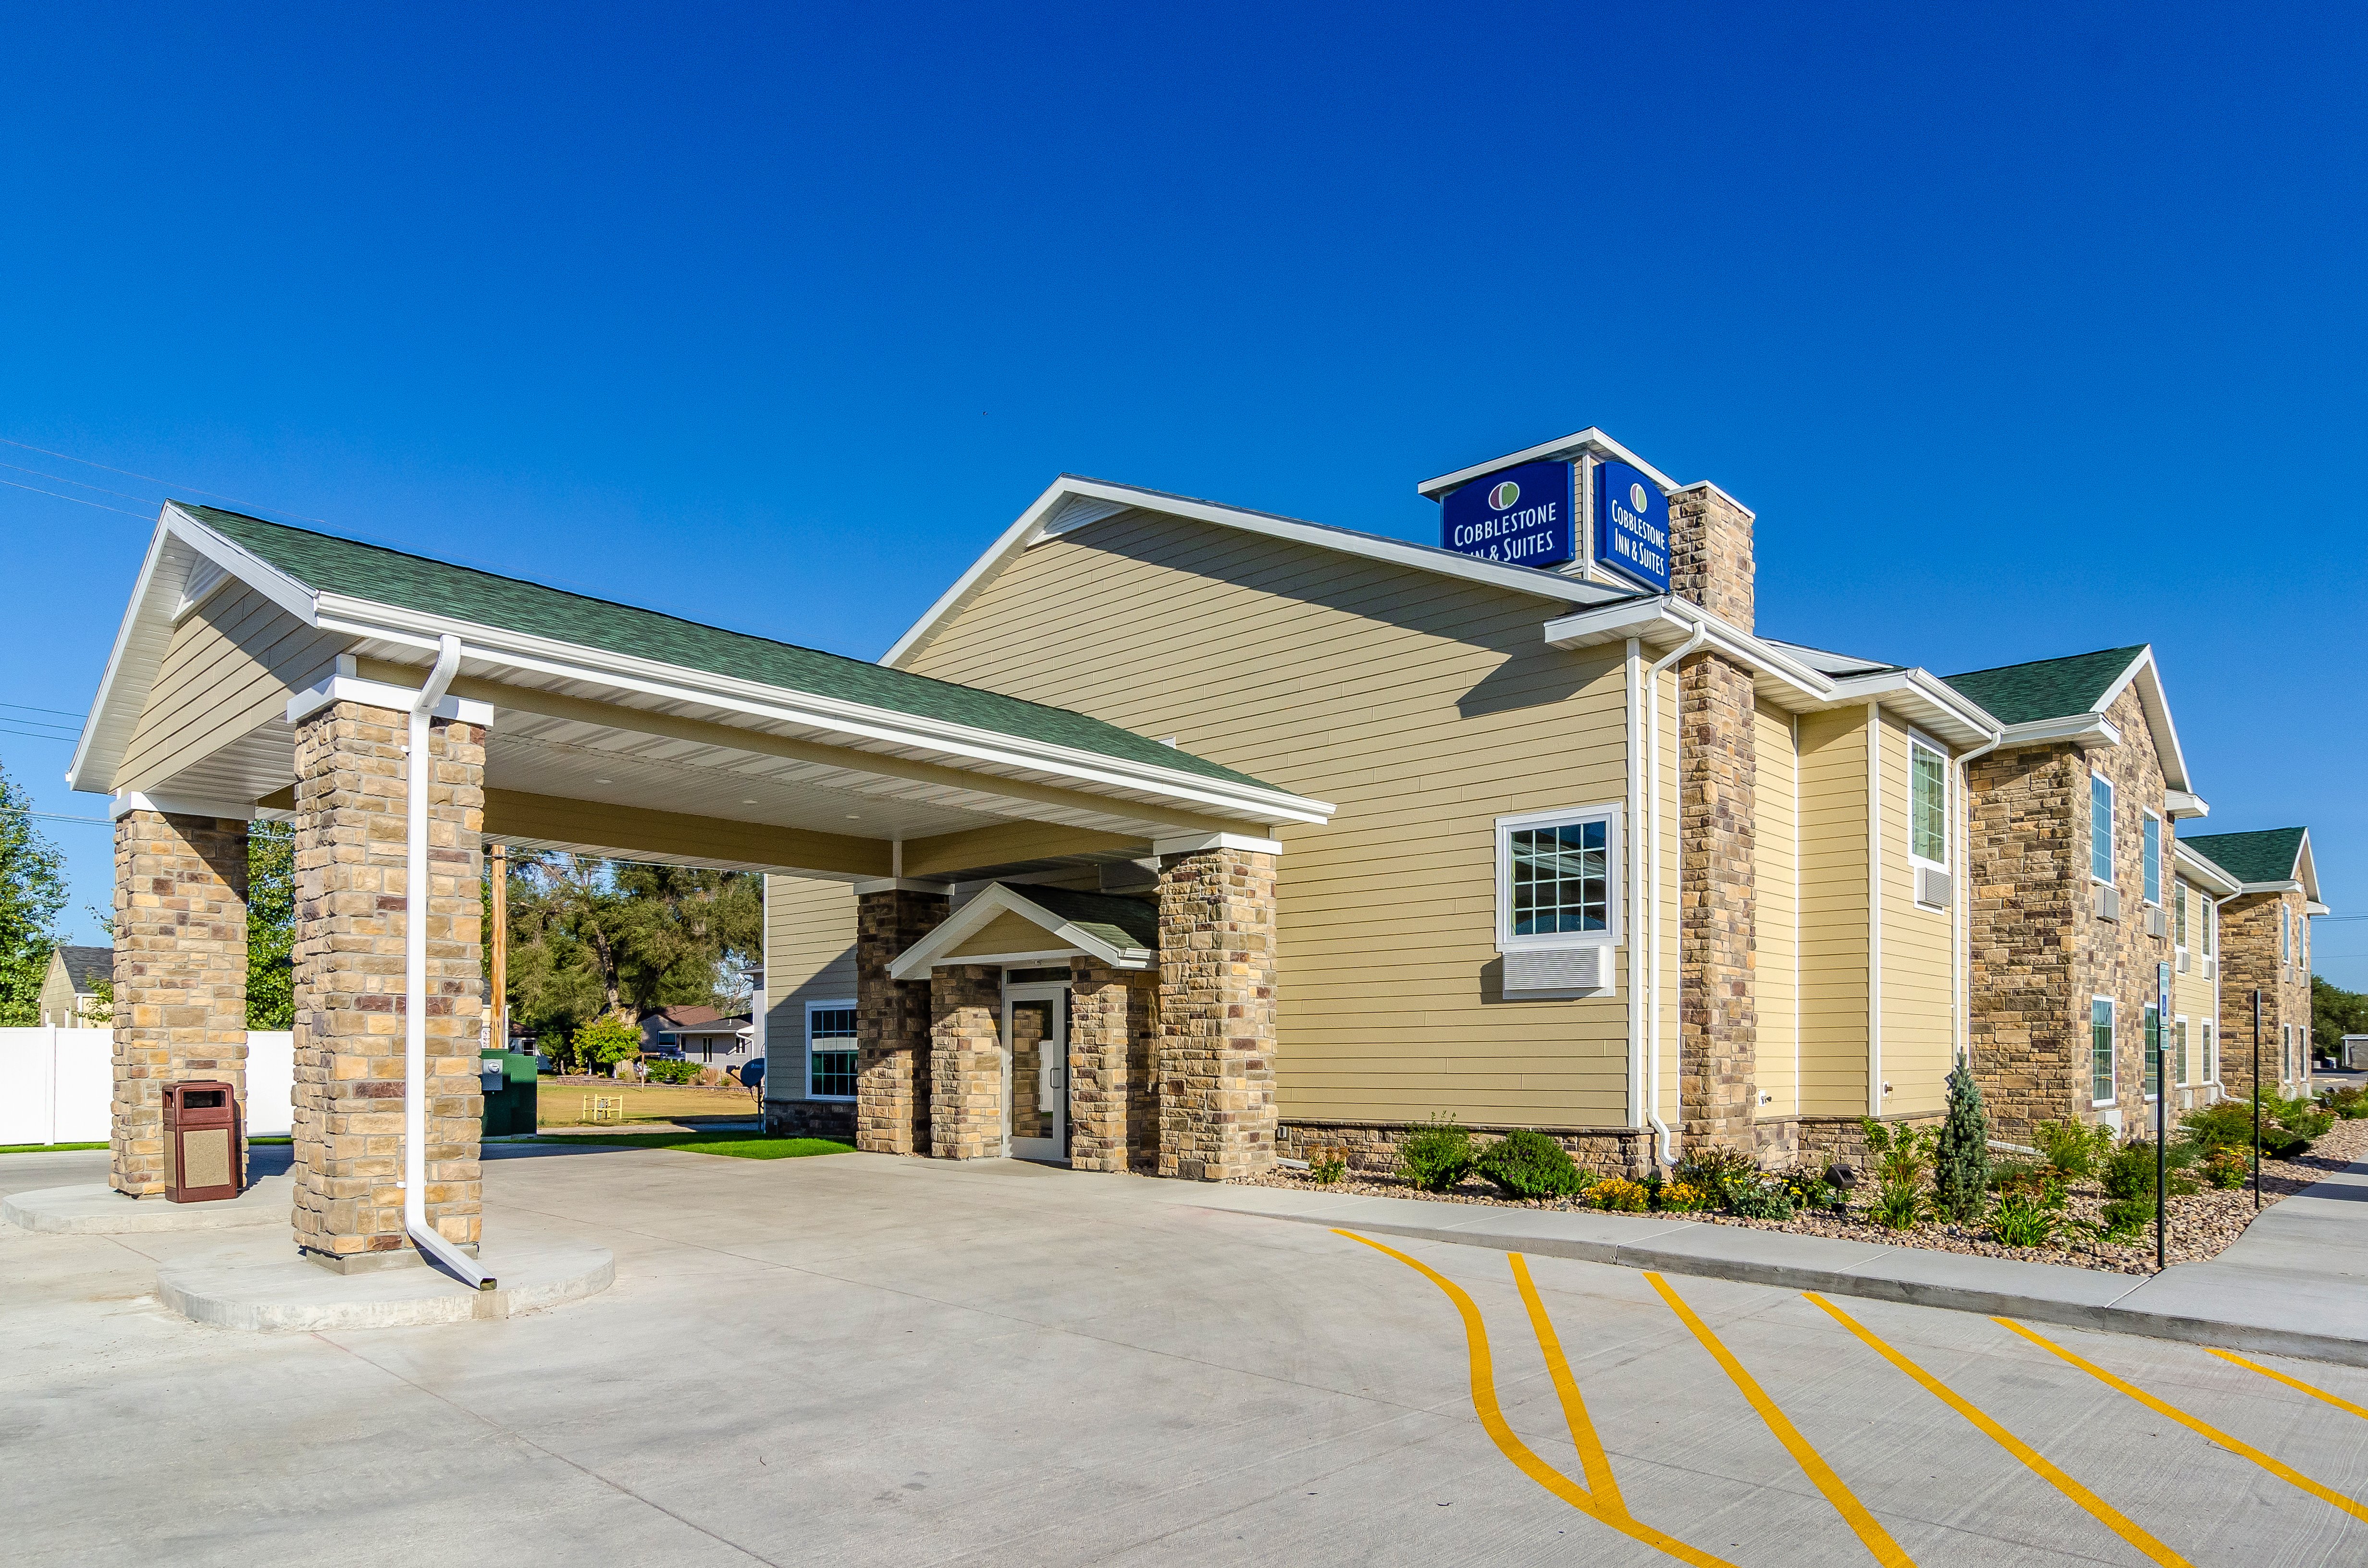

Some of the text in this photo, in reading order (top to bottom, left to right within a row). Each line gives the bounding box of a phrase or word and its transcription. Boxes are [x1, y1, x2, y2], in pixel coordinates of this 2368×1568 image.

[1455, 502, 1556, 547] COBBLESTONE
[1504, 531, 1553, 562] SUITES
[1612, 499, 1665, 551] COBBLESTONE
[1615, 527, 1664, 576] INN & SUITES
